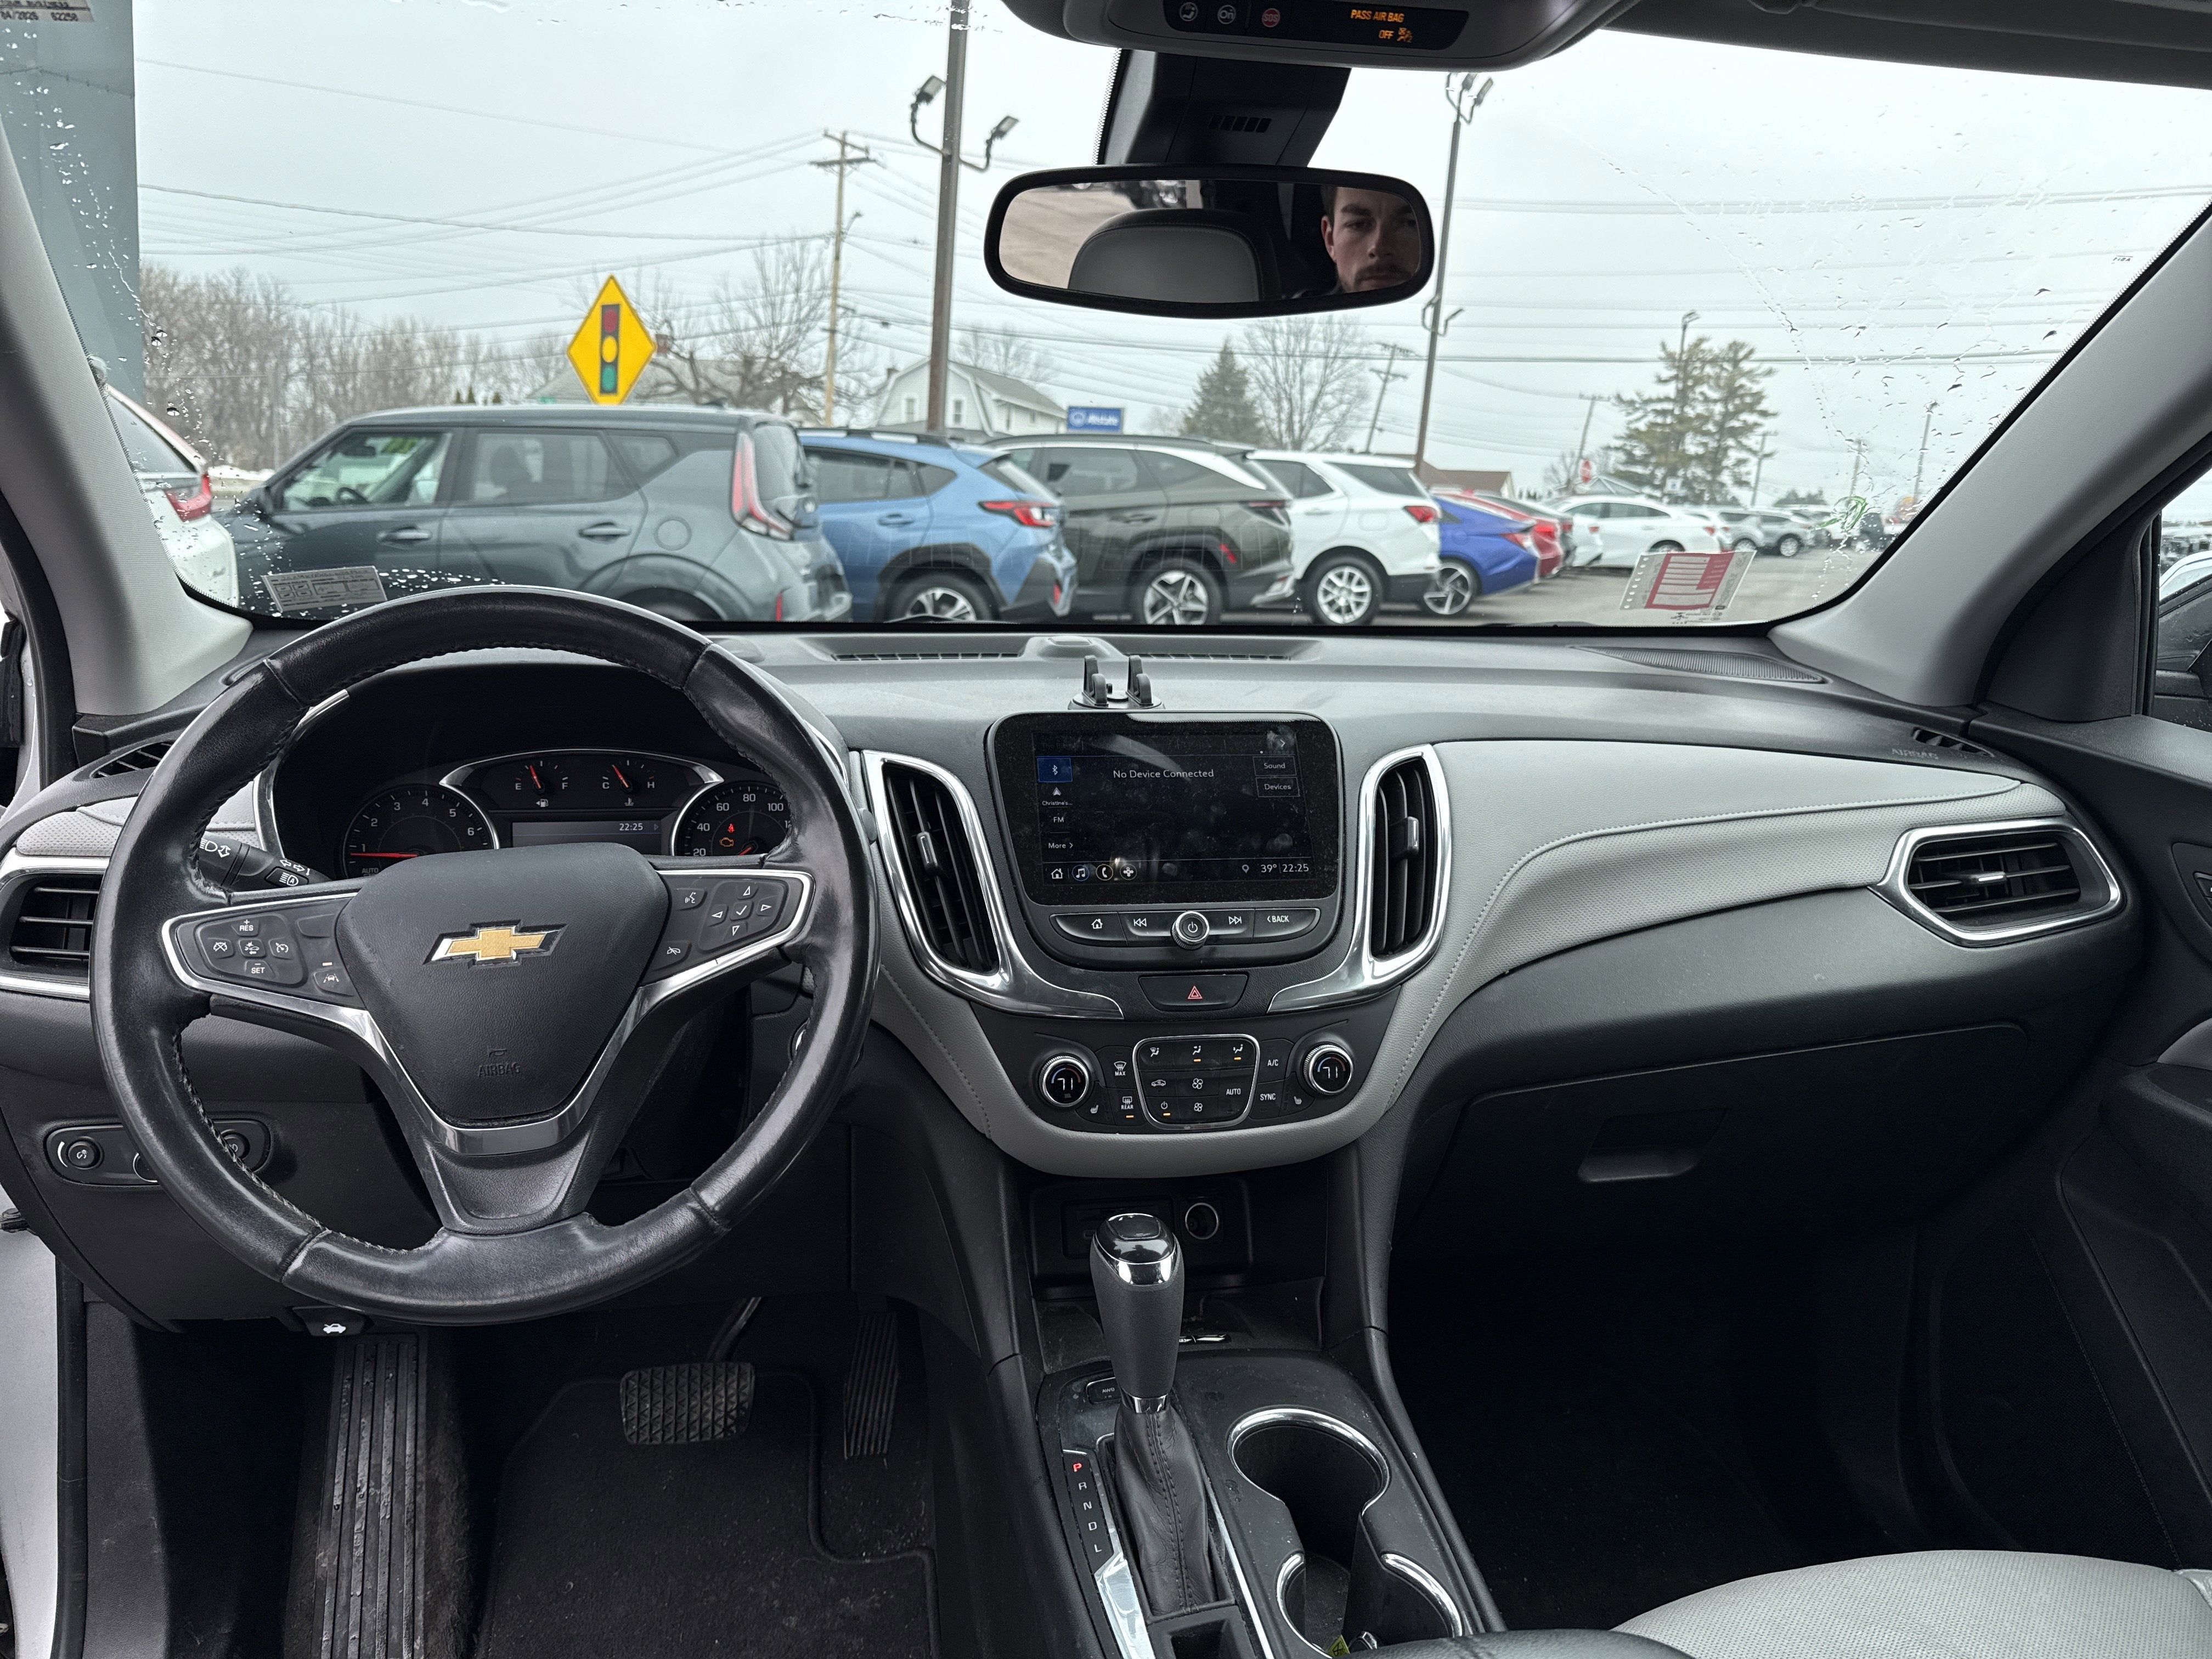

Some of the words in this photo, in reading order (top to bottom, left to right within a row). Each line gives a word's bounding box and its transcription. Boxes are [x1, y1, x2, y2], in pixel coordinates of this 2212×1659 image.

[1263, 14, 1278, 22] SOS
[1351, 9, 1372, 20] PASS
[1373, 12, 1387, 21] AIR
[1387, 12, 1404, 22] BAG
[1378, 30, 1394, 40] OFF
[1113, 770, 1127, 778] No
[1130, 770, 1160, 778] Device
[1163, 769, 1214, 778] Connected
[422, 798, 429, 806] 4
[743, 794, 756, 802] 80
[394, 802, 401, 811] 3
[768, 803, 783, 811] 100
[449, 809, 456, 817] 5
[371, 818, 378, 827] 2
[619, 823, 643, 831] 22:25
[697, 823, 710, 831] 40
[467, 827, 475, 836] 6
[362, 844, 366, 852] 1
[693, 848, 706, 856] 20
[1282, 864, 1309, 872] 22:25
[478, 1062, 520, 1077] AIRBAG
[1323, 1066, 1338, 1079] 71
[1057, 1077, 1073, 1091] 71
[1073, 1463, 1082, 1472] P
[1083, 1501, 1092, 1510] N
[1088, 1521, 1097, 1531] D
[1094, 1544, 1102, 1553] L
